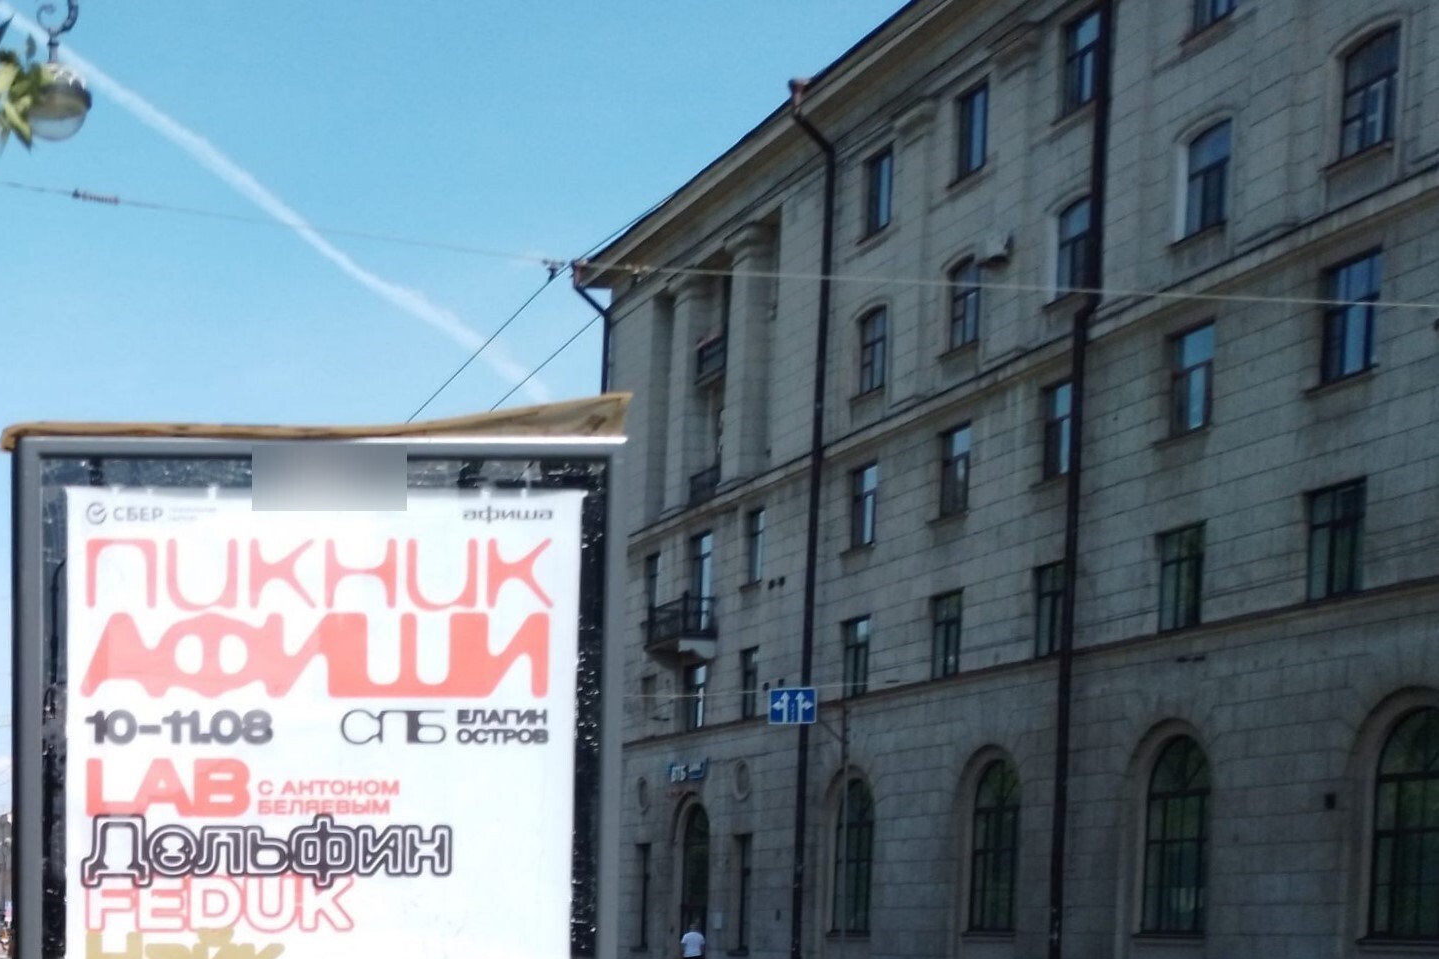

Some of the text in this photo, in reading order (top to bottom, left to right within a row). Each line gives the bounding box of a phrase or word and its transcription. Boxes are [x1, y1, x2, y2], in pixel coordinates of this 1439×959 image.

[113, 506, 164, 522] СБЕР
[463, 505, 553, 524] афиша
[86, 538, 553, 611] ПИКНИК
[80, 612, 550, 698] АФИШИ
[341, 709, 446, 745] СПБ
[457, 709, 548, 725] ЕЛАГИН
[457, 728, 549, 744] ОСТРОВ
[86, 758, 251, 818] LAB
[258, 779, 401, 796] С АНТОНОМ
[257, 798, 390, 816] БЕЛЯЕВЫМ
[81, 814, 453, 889] Дольфин
[85, 873, 355, 933] FEDUK
